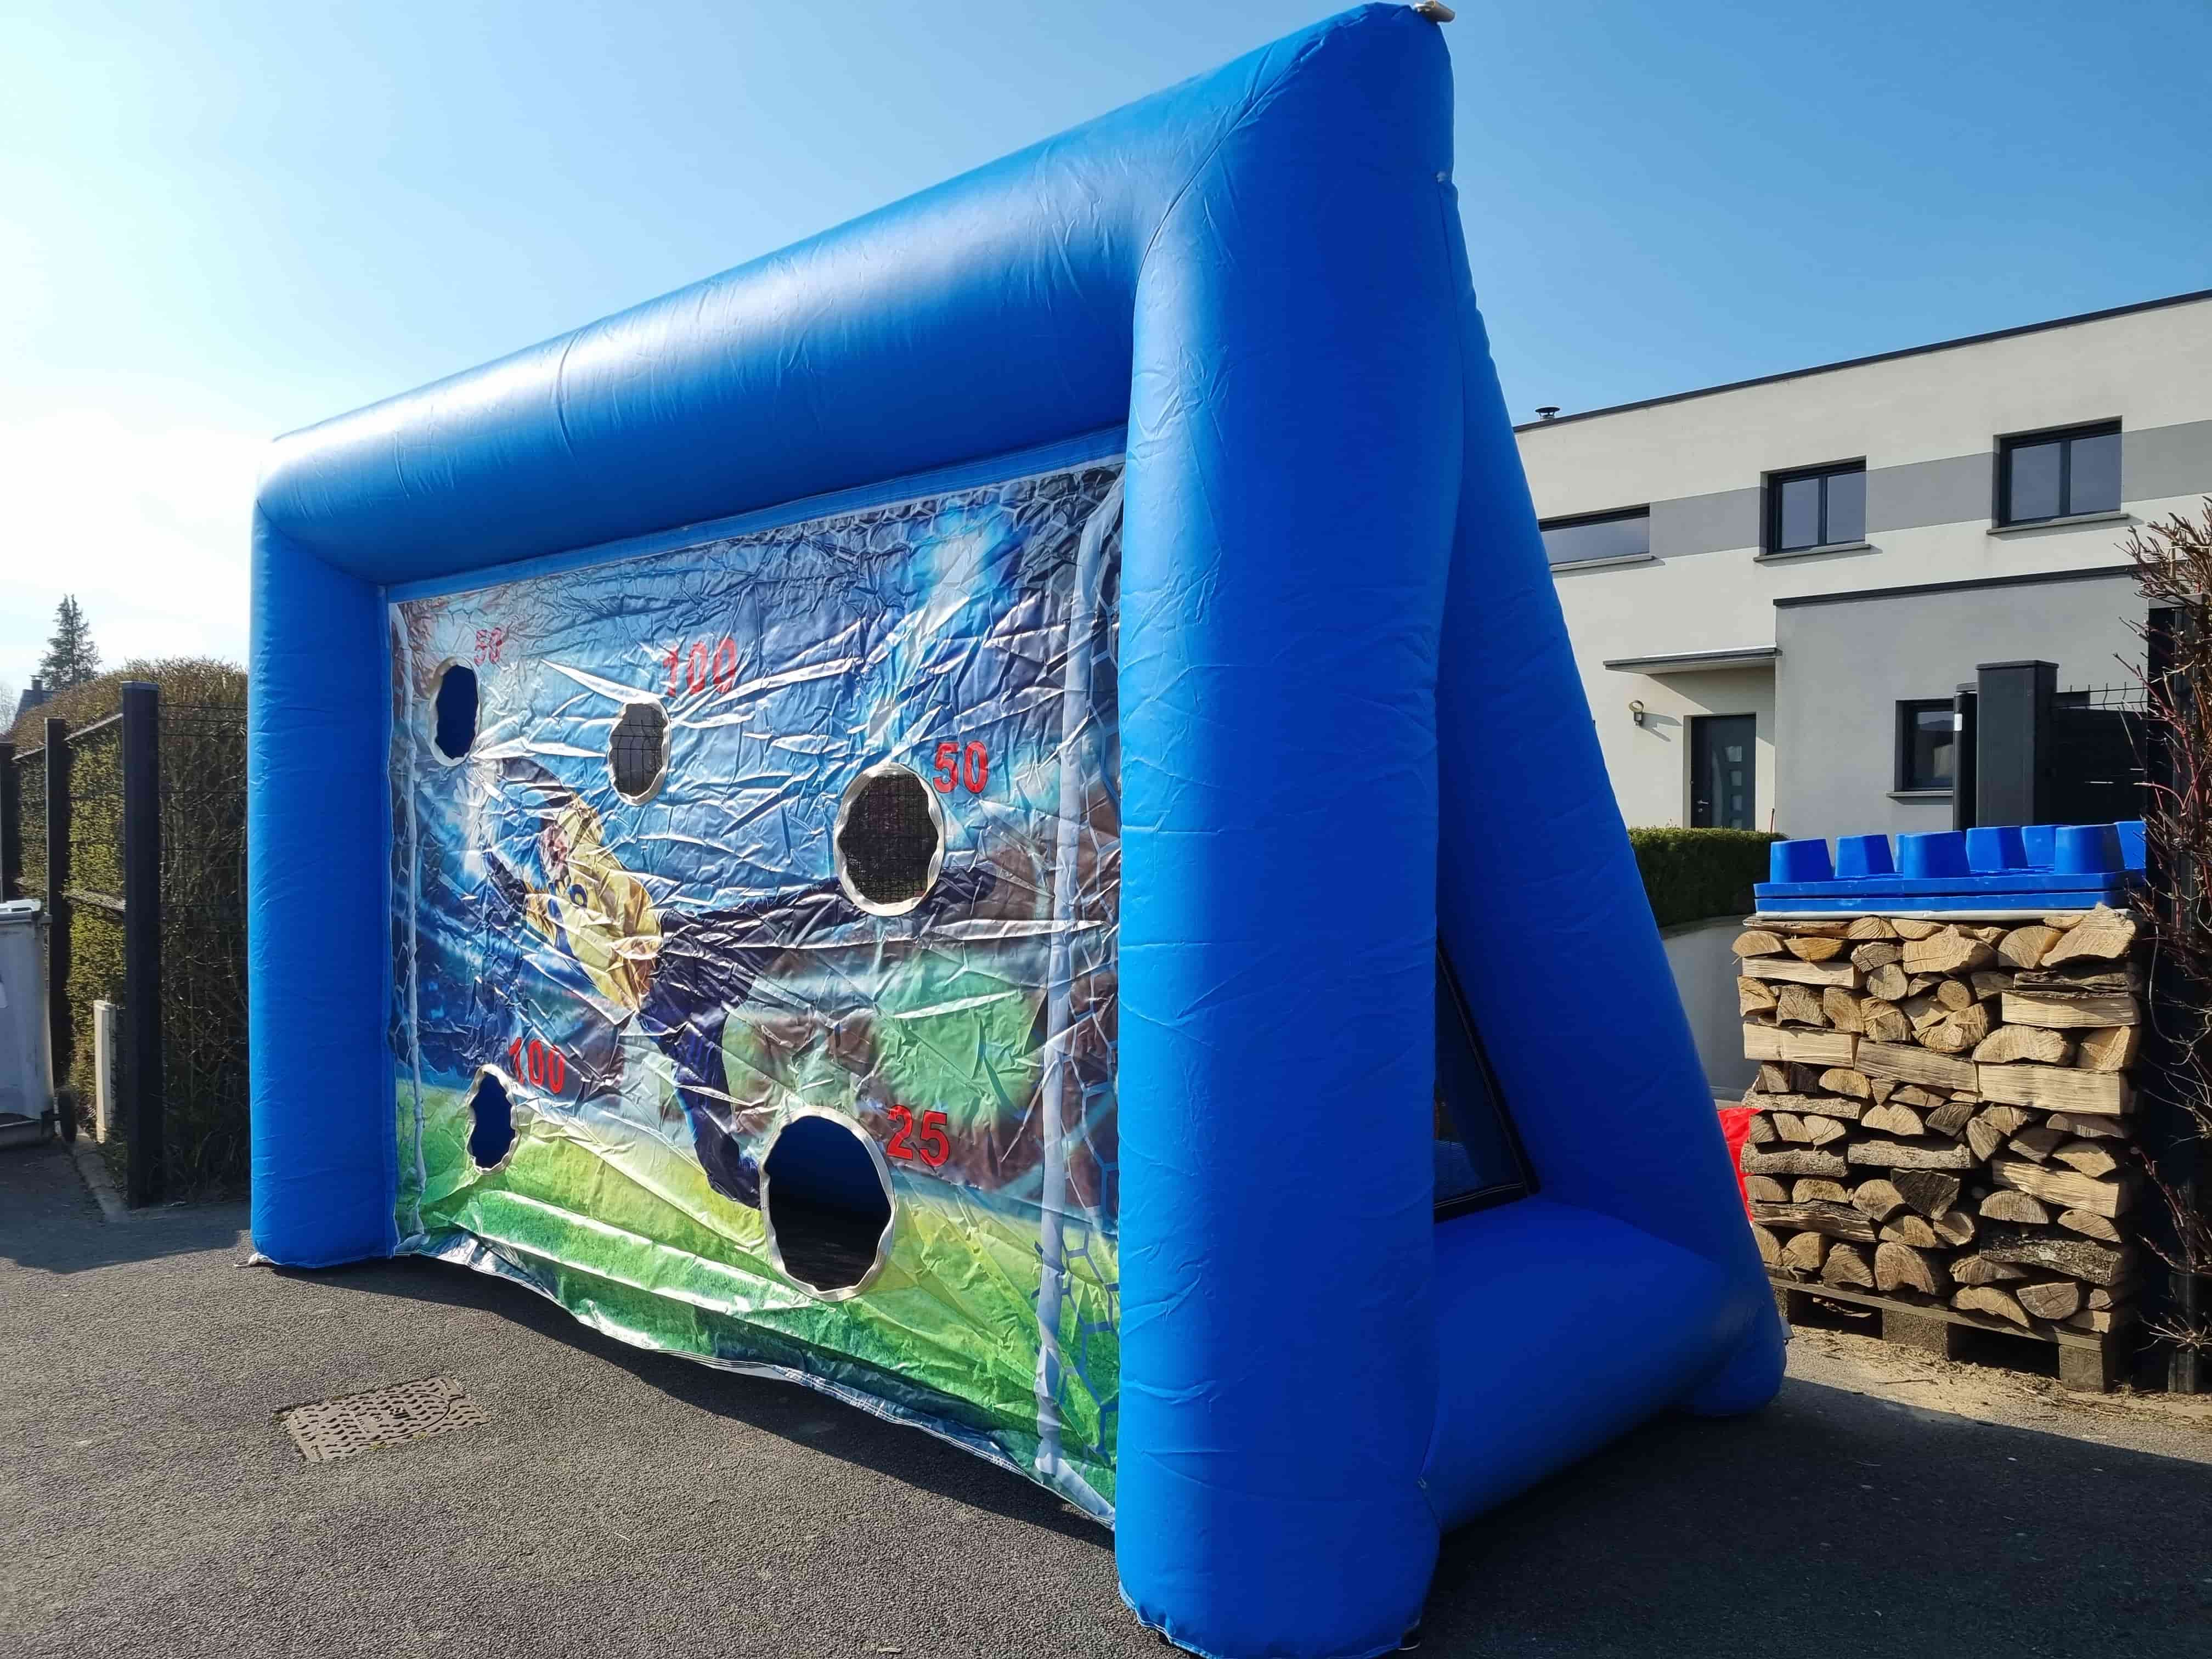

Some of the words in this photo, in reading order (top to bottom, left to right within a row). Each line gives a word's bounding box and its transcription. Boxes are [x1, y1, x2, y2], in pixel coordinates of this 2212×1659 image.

[663, 637, 737, 698] 100
[933, 741, 988, 794] 50
[509, 1037, 565, 1094] 100
[887, 1104, 950, 1167] 25
